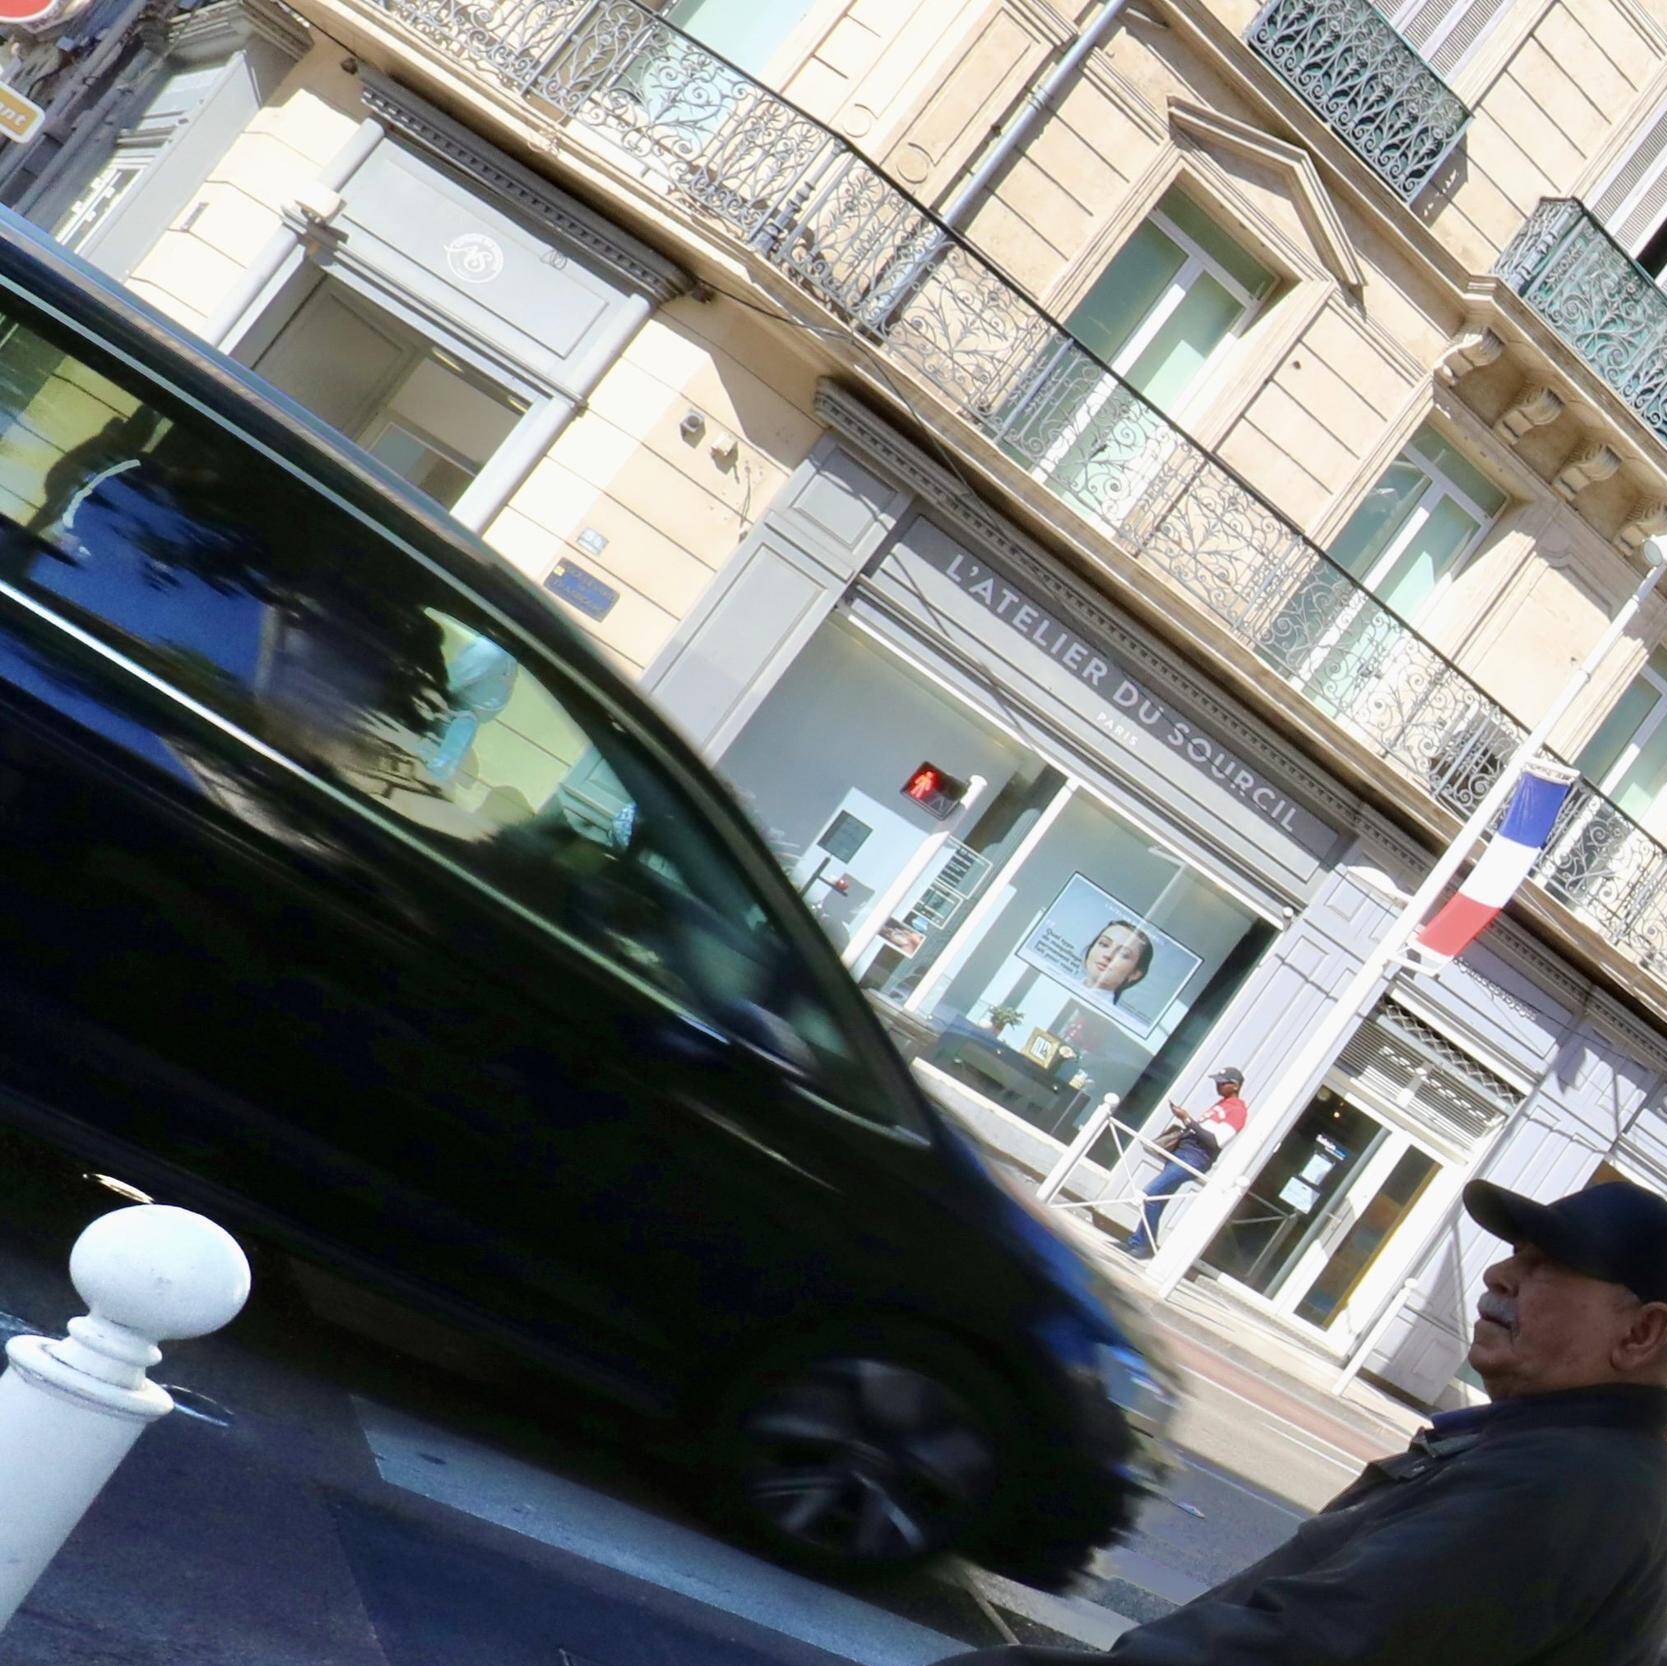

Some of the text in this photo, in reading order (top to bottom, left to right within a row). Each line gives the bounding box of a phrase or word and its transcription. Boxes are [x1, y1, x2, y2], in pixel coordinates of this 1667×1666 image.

[945, 552, 1298, 833] L'ATELIER DU SOURCIL
[1096, 711, 1139, 748] PARIS
